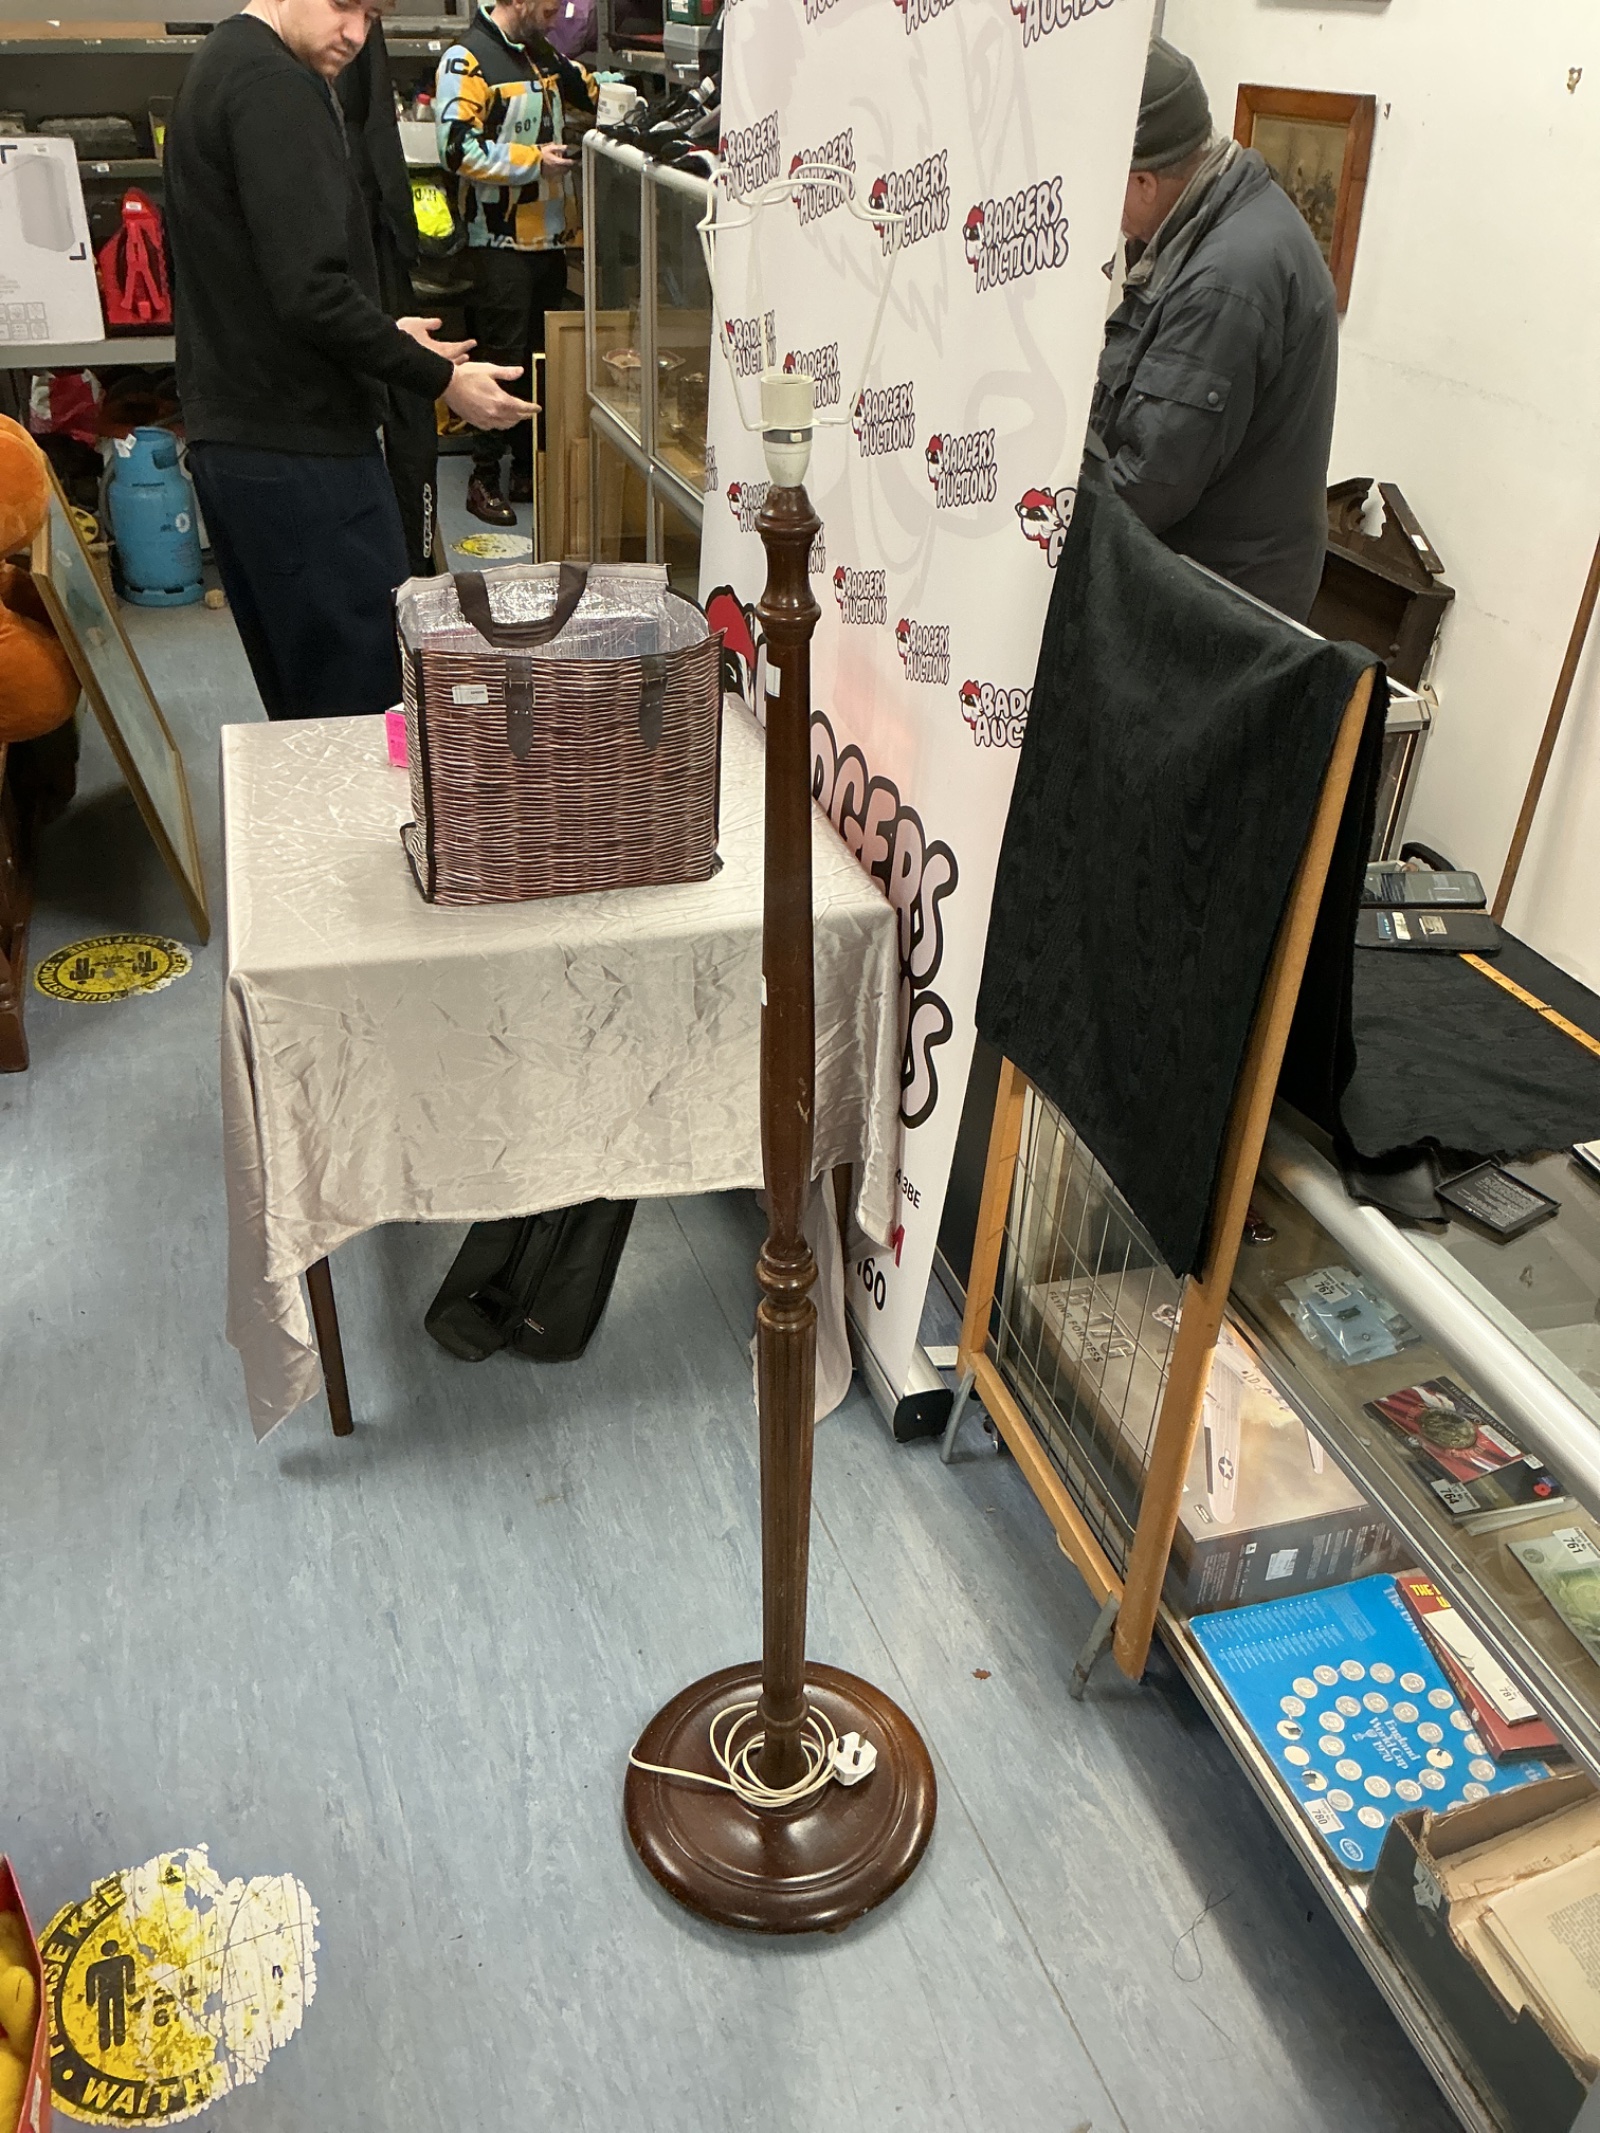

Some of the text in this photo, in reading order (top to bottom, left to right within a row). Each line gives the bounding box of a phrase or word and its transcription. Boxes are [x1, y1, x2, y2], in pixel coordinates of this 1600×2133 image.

[727, 110, 779, 166] BADGERS
[726, 140, 780, 201] AUCTIONS
[887, 149, 948, 214] BADGERS
[983, 175, 1063, 248] BADGERS
[976, 218, 1070, 293] AUCTIONS
[794, 342, 839, 380] BADGERS
[864, 381, 914, 424] BADGERS
[860, 412, 916, 458] AUCTIONS
[942, 428, 996, 474] BADGERS
[936, 462, 998, 509] AUCTIONS
[845, 567, 886, 599] BADGERS
[841, 596, 888, 625] AUCTIONS
[909, 620, 950, 656] BADGERS
[905, 652, 951, 686] AUCTIONS
[1314, 1281, 1334, 1296] 767
[1049, 1290, 1104, 1363] FLYING FORTRESS
[1440, 1487, 1460, 1505] 764
[1562, 1536, 1584, 1554] 761
[1409, 1583, 1435, 1597] THE
[1499, 1687, 1516, 1702] 781
[1369, 1716, 1409, 1770] World Cup
[1372, 1740, 1394, 1762] 1970
[1384, 1719, 1422, 1761] England
[1311, 1808, 1329, 1825] 780
[81, 2076, 173, 2115] WAIT
